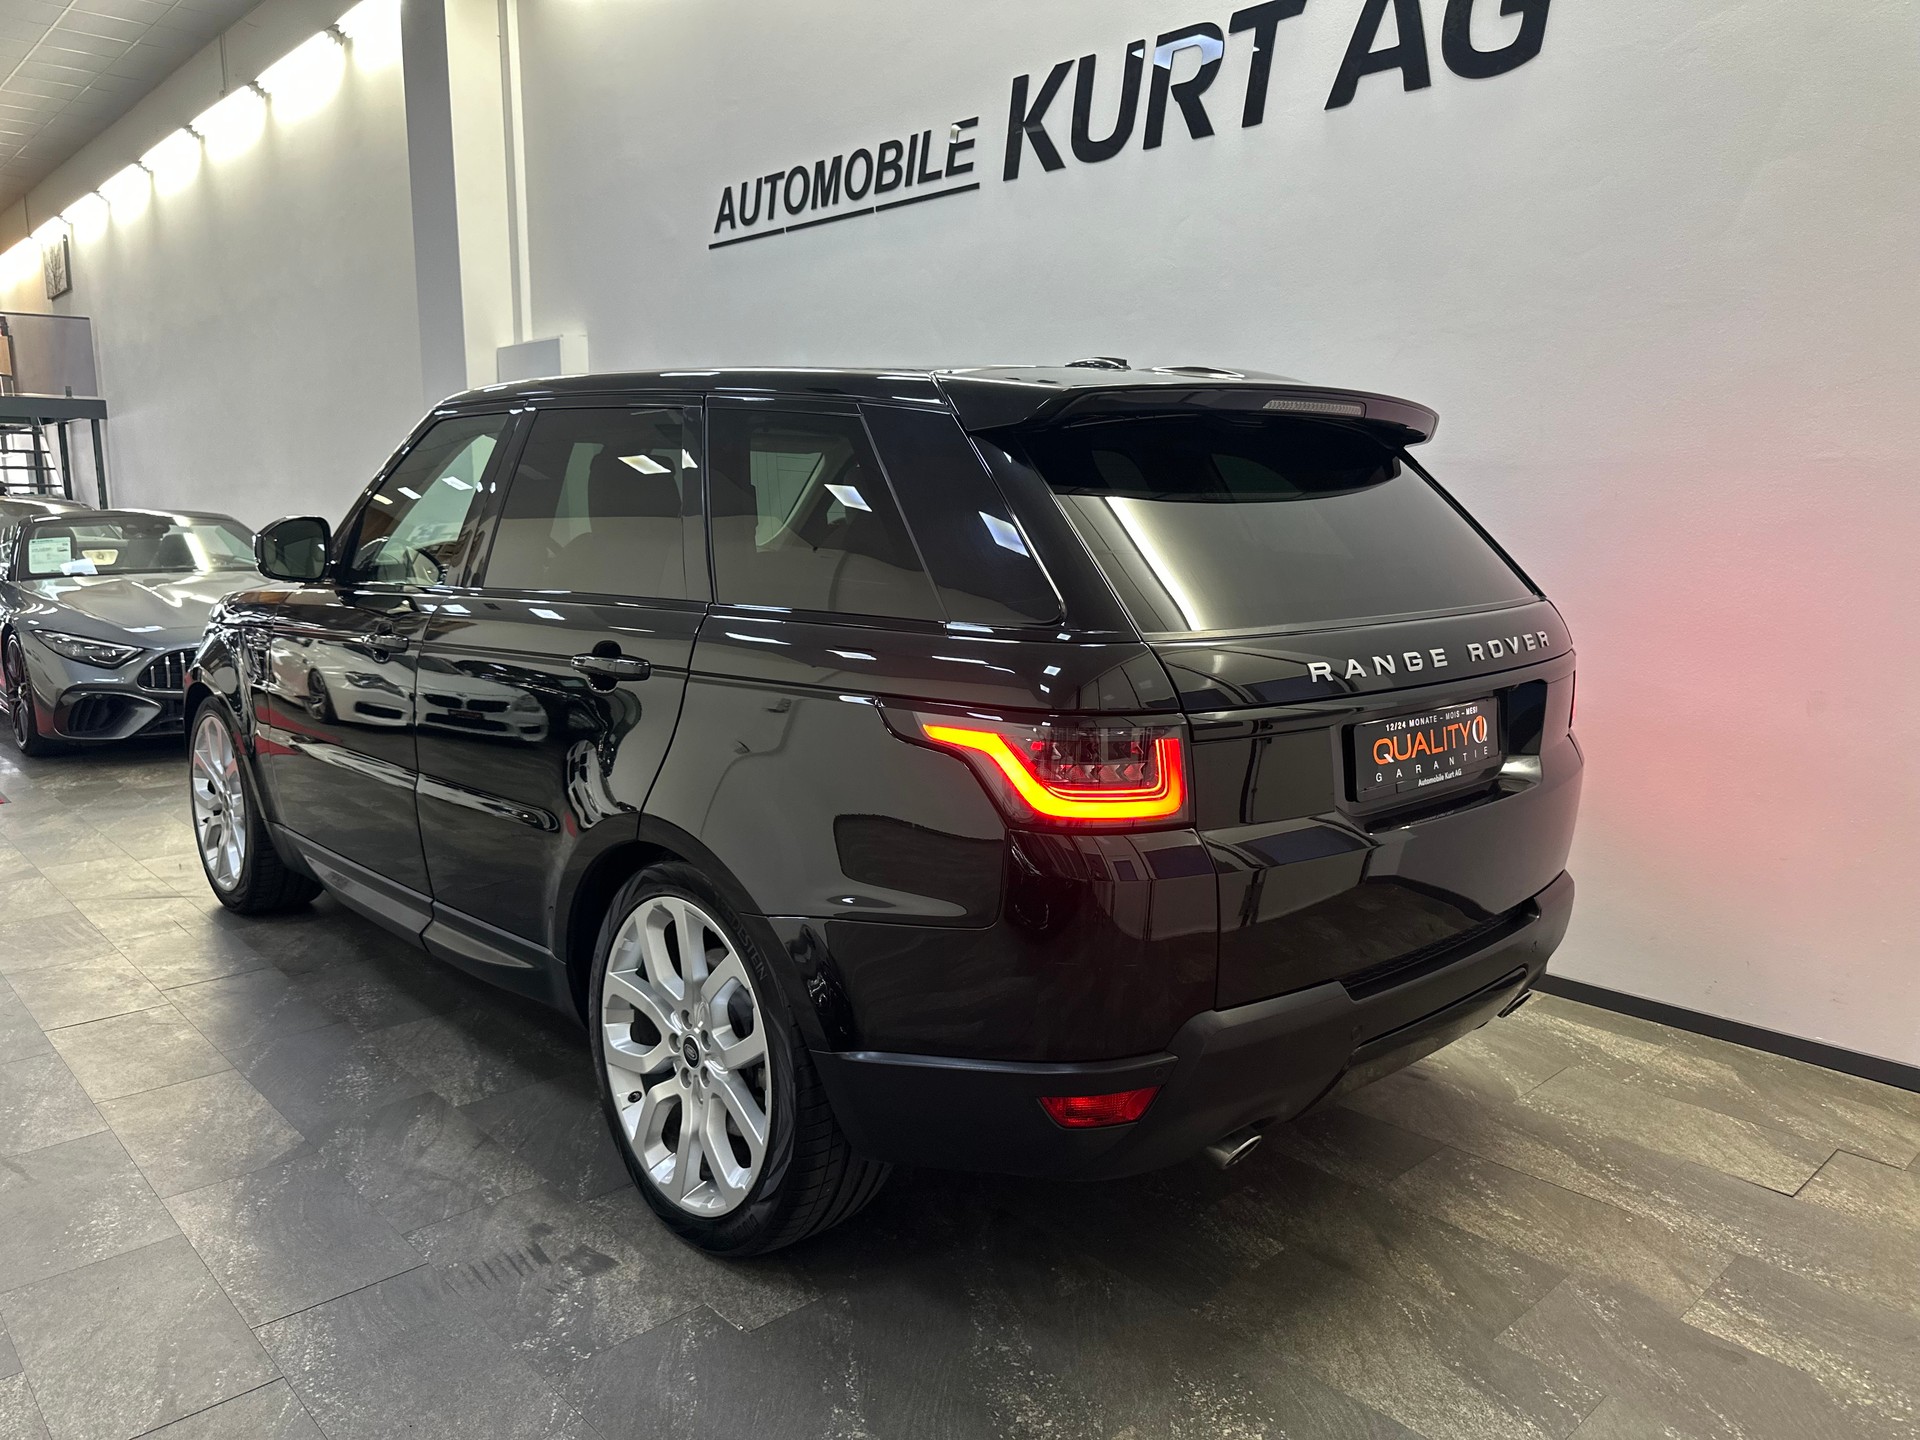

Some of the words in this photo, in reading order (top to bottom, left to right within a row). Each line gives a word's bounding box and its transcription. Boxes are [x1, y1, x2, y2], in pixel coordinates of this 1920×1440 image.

[714, 116, 979, 234] AUTOMOBILE
[1003, 0, 1304, 181] KURT
[1307, 648, 1448, 683] RANGE
[1466, 630, 1550, 662] ROVER
[1385, 720, 1406, 732] 12/24
[1408, 714, 1437, 728] MONATE
[1445, 710, 1460, 720] MOIS
[1375, 746, 1488, 782] GARANTIE
[1417, 773, 1445, 787] Automobile
[1444, 770, 1455, 780] Kurt
[1454, 768, 1462, 778] AG
